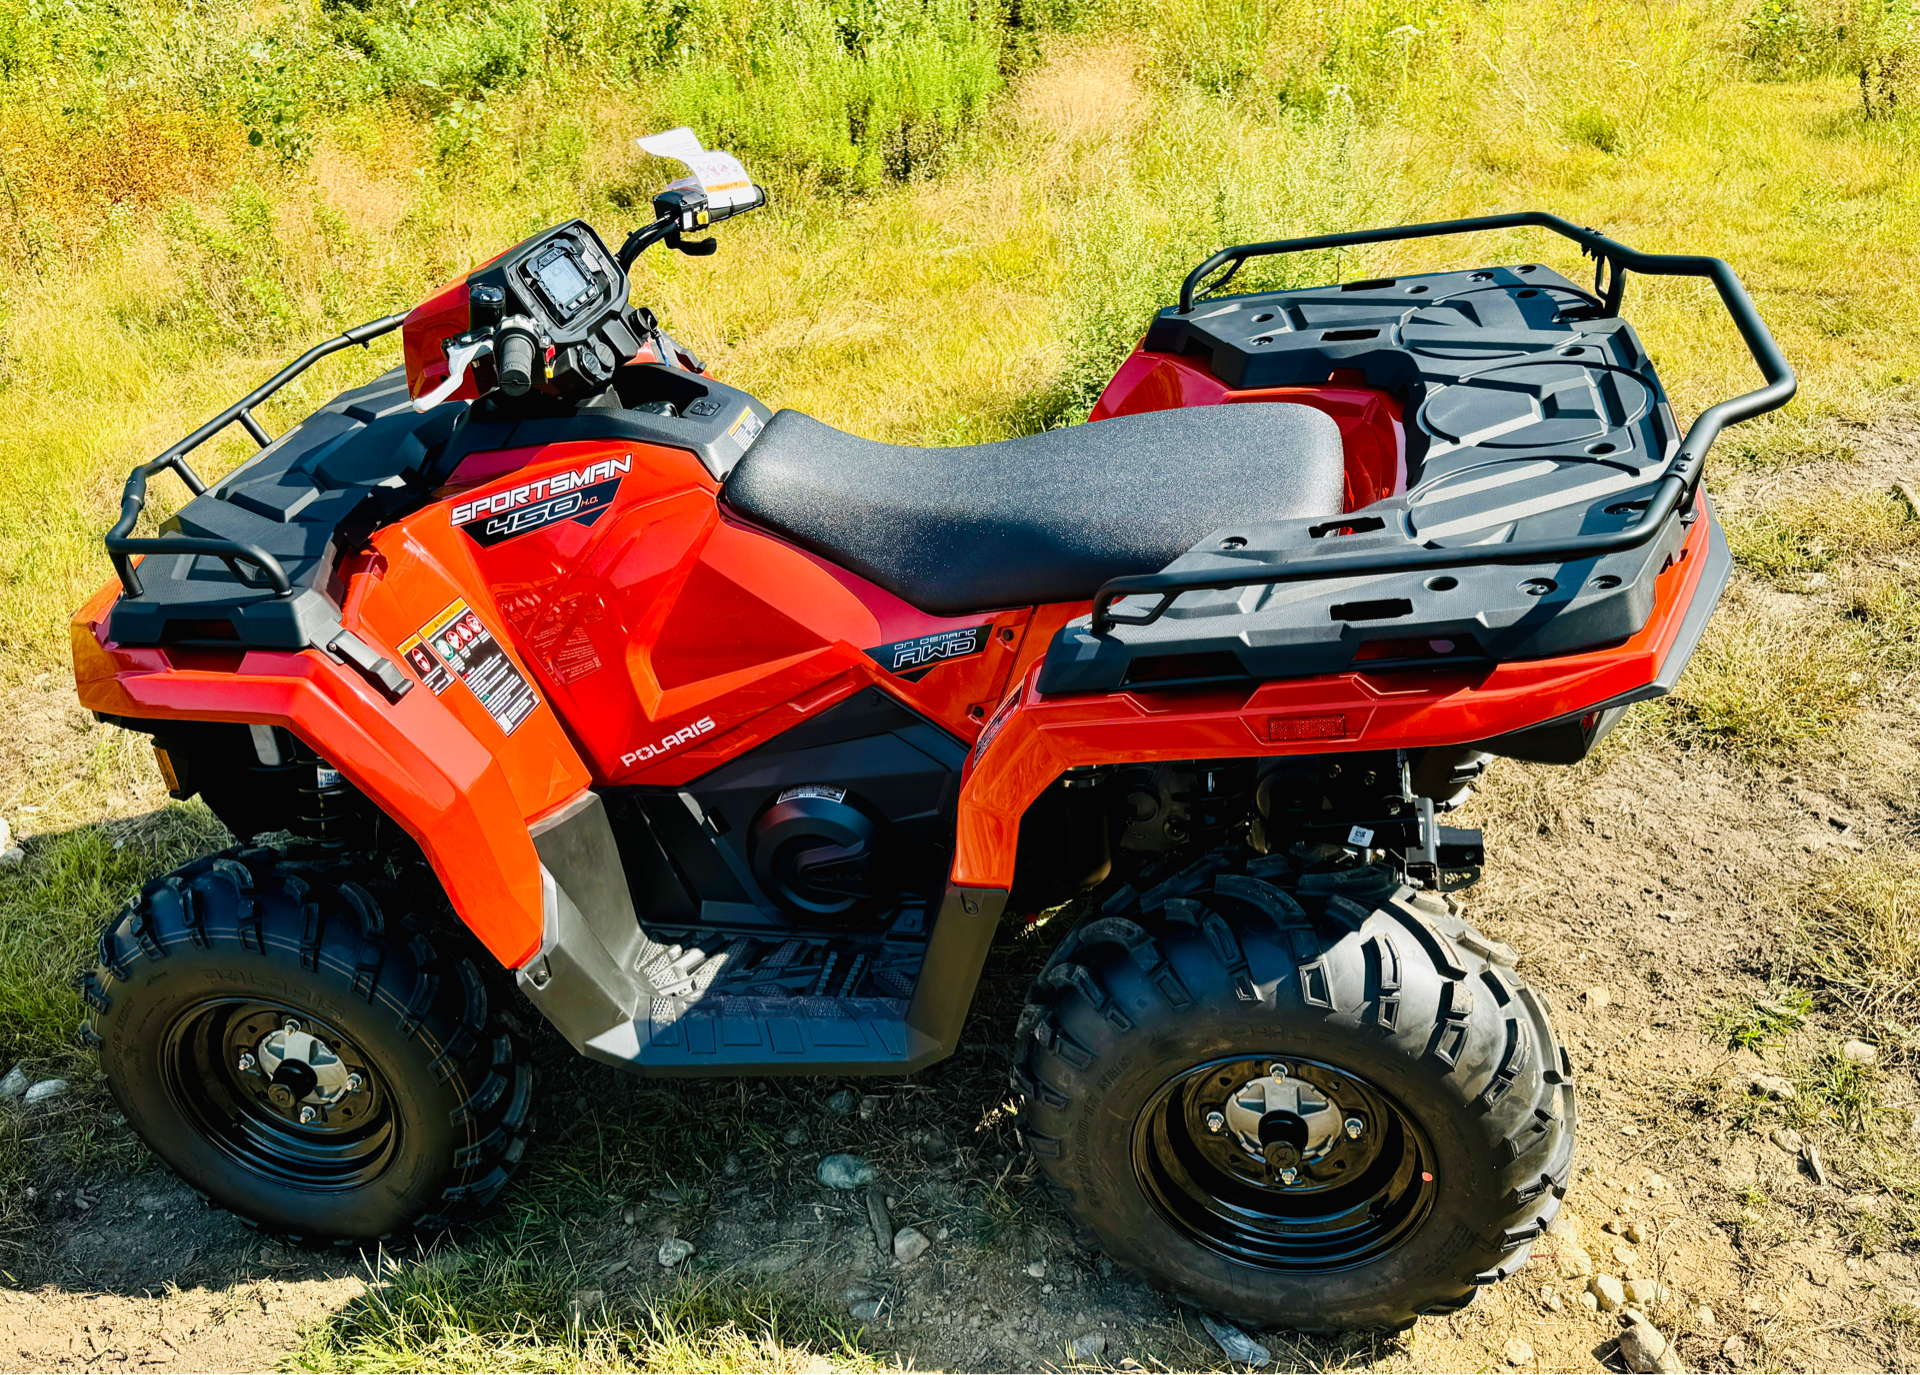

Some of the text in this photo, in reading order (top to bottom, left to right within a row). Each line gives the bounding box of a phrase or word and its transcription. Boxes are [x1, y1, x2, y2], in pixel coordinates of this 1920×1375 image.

[450, 454, 632, 526] SPORTSMAN
[486, 493, 599, 535] 450 H.O.
[893, 637, 976, 668] AWD
[894, 629, 977, 650] ON DEMAND
[620, 716, 716, 767] POLARIS
[202, 969, 346, 1021] POLARIS
[1233, 1023, 1406, 1073] POLARIS
[1096, 1053, 1132, 1092] NHS
